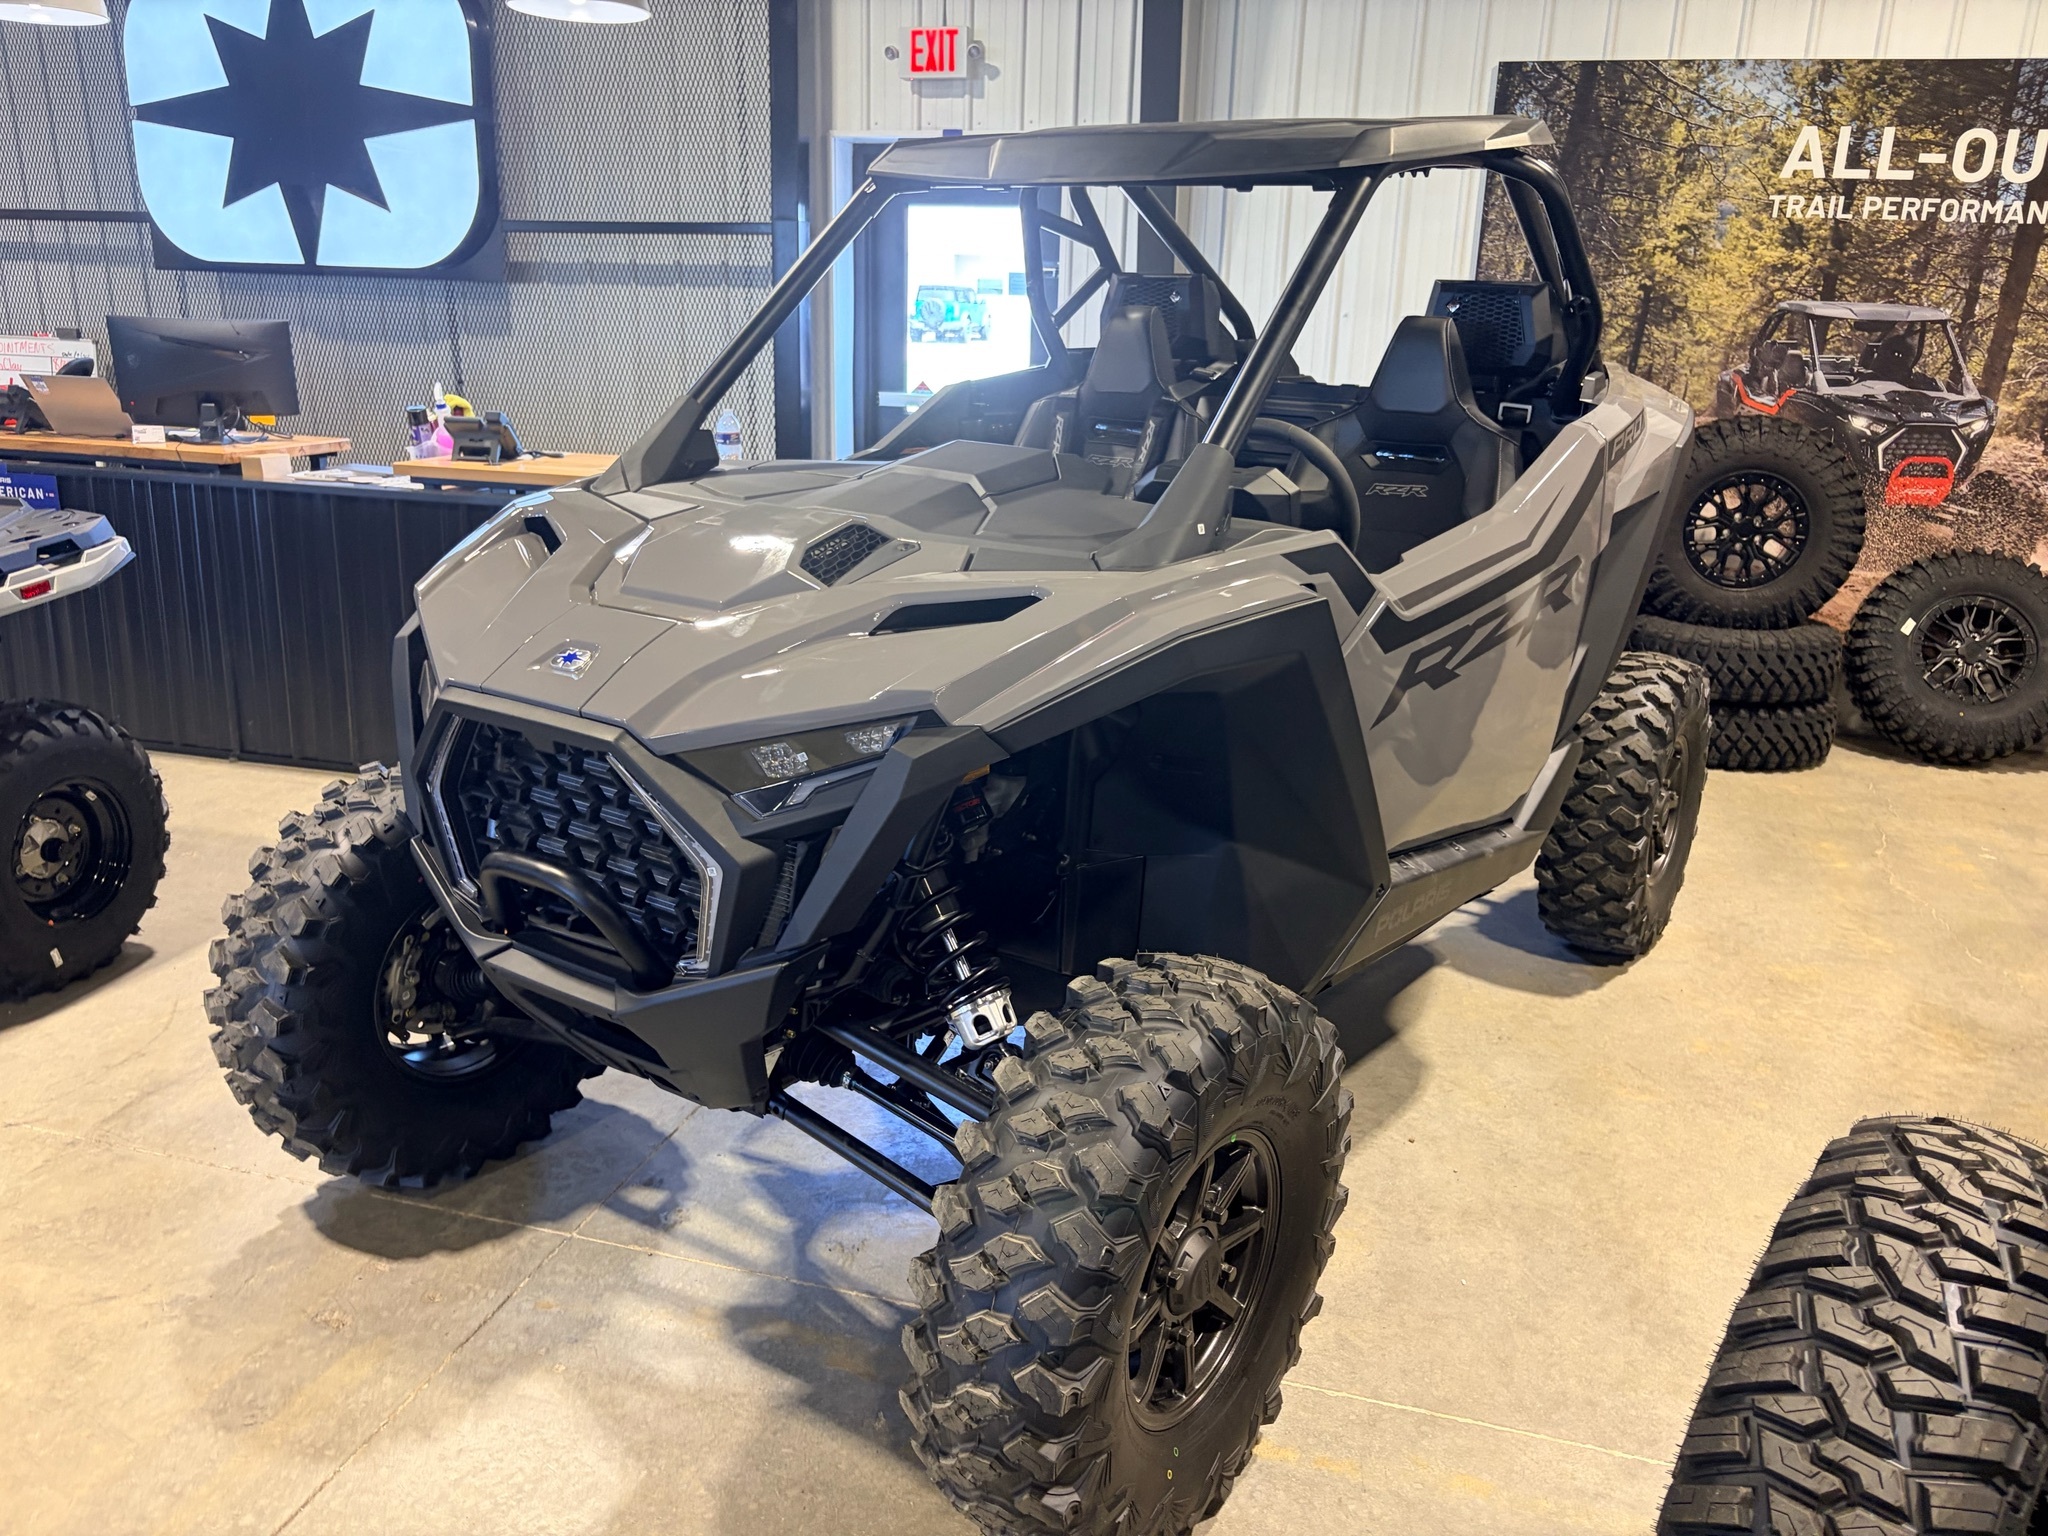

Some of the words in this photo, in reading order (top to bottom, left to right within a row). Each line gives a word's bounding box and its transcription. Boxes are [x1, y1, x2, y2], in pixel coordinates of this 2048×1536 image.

[911, 29, 959, 72] EXIT
[1779, 125, 2048, 184] ALL-OU
[1769, 195, 1853, 219] TRAIL
[1862, 196, 2048, 225] PERFORMAN
[1611, 414, 1643, 460] PRO
[1088, 454, 1135, 468] RZR
[1365, 483, 1429, 498] RZR
[1369, 555, 1583, 731] RZR
[1374, 883, 1451, 939] POLARIS
